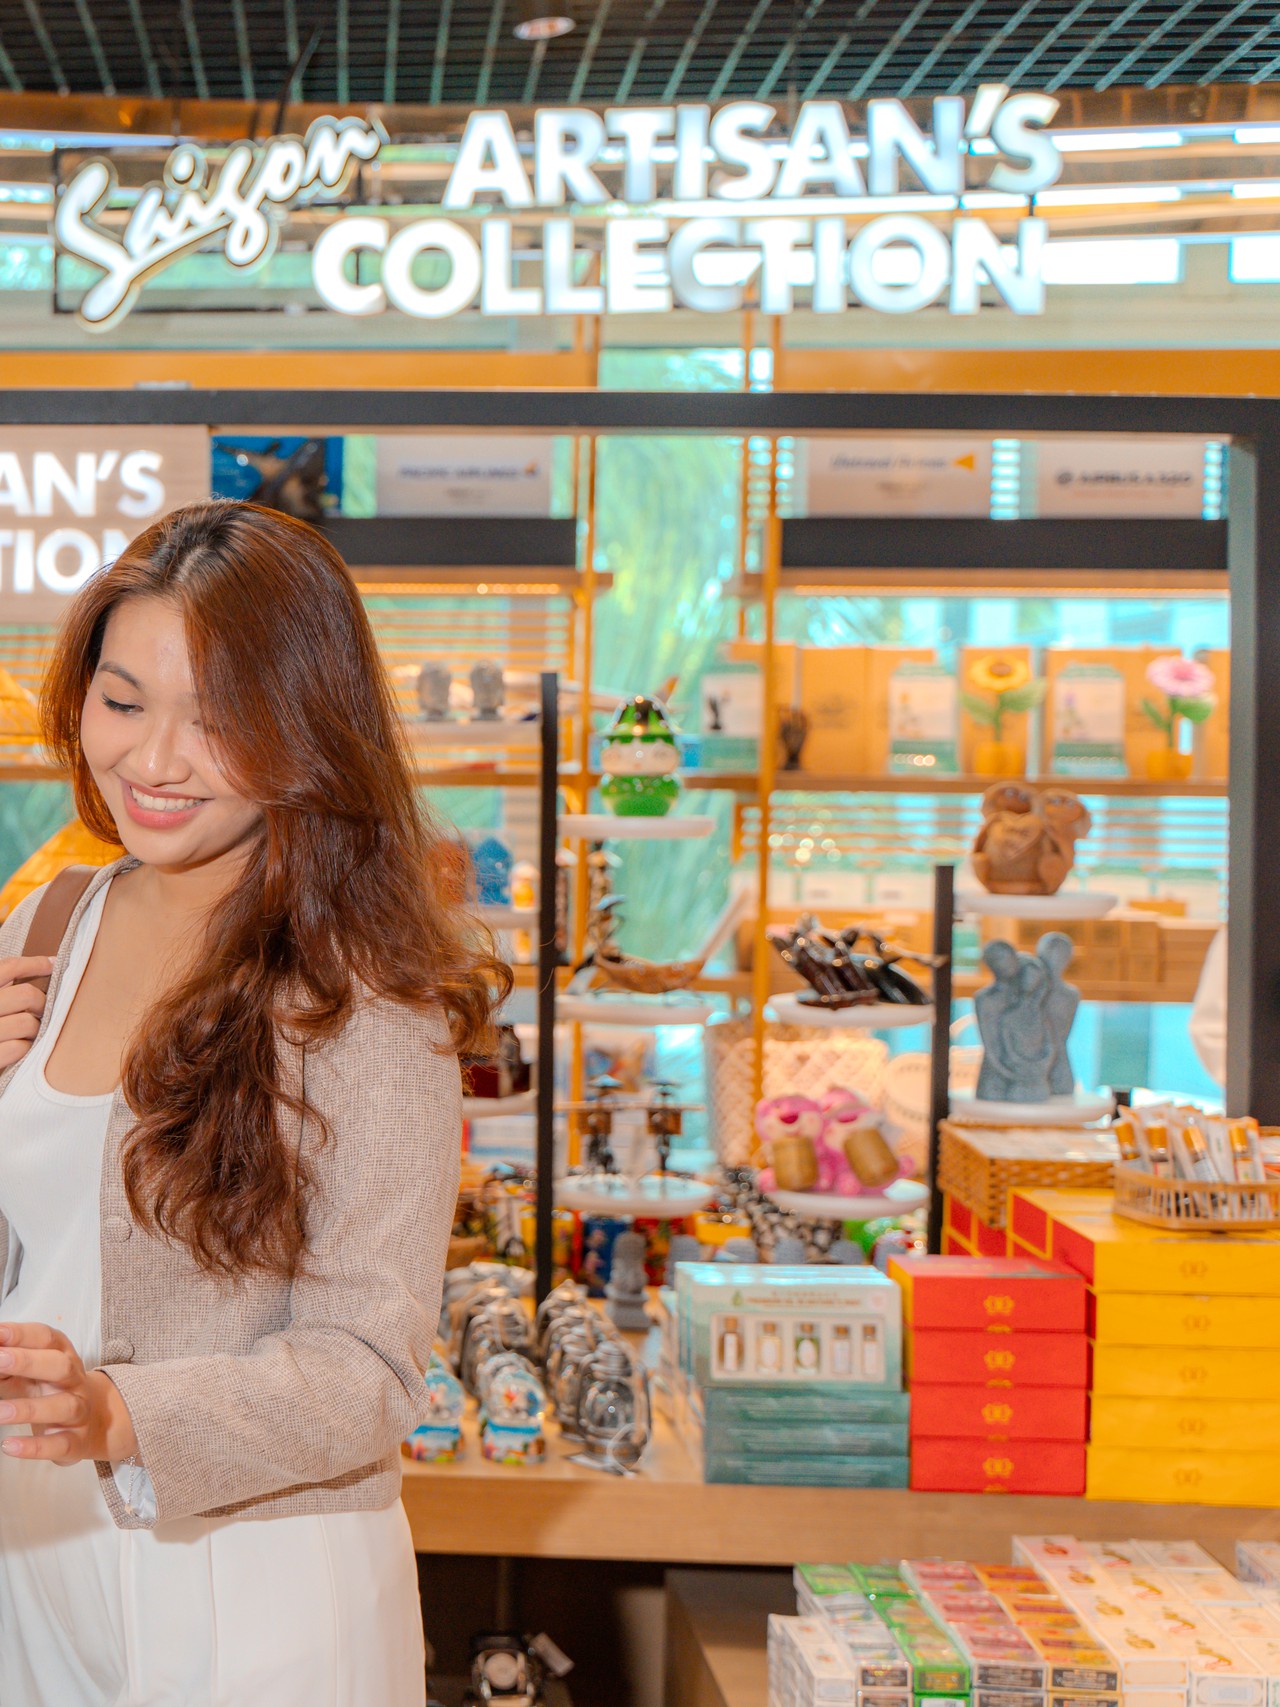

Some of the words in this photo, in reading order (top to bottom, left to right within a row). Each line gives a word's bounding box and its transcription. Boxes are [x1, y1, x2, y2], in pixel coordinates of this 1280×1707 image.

[55, 120, 381, 325] Saigon
[444, 84, 1063, 208] ARTISAN'S
[310, 216, 1047, 318] COLLECTION
